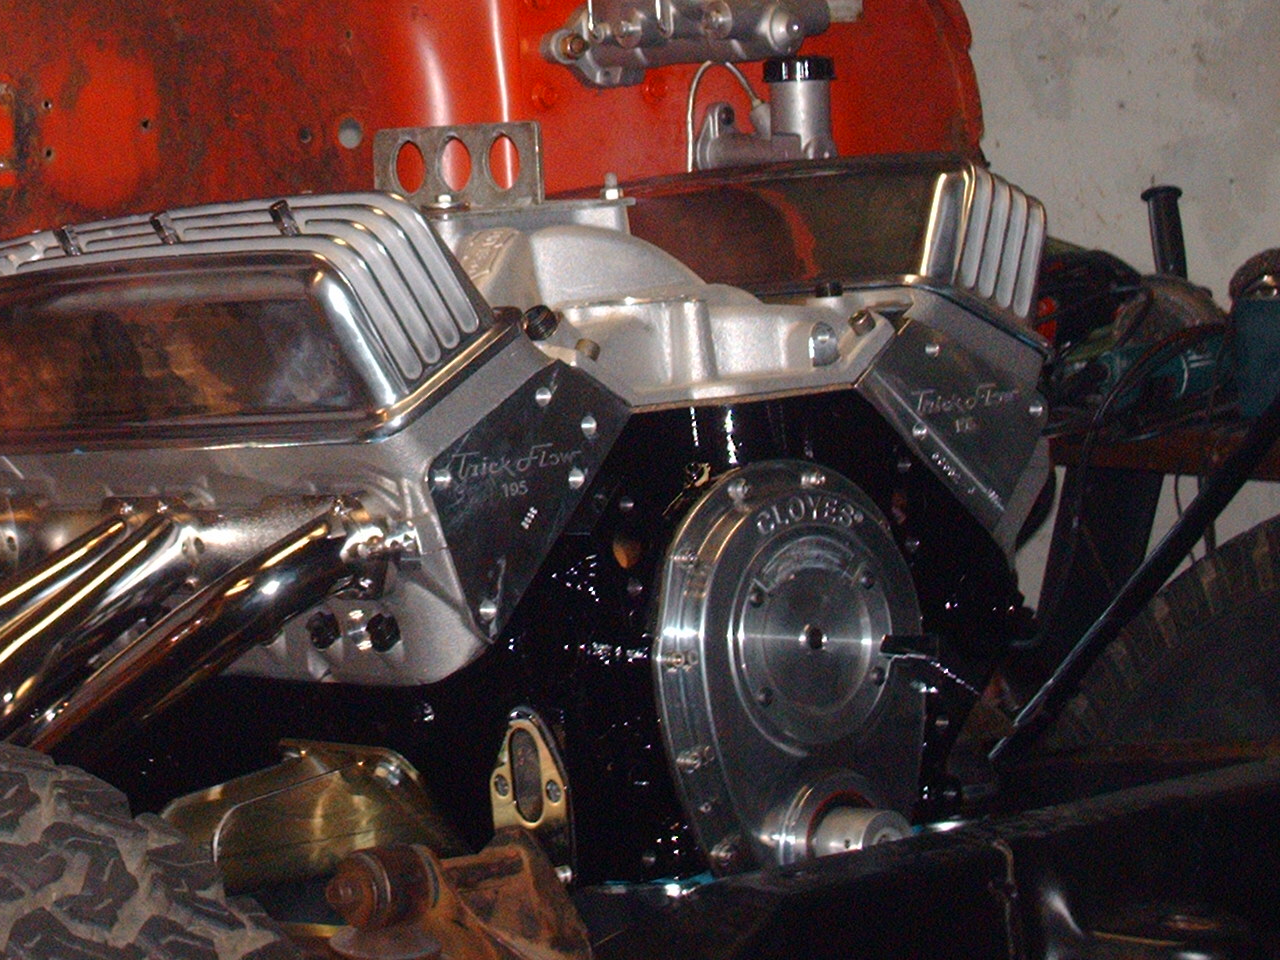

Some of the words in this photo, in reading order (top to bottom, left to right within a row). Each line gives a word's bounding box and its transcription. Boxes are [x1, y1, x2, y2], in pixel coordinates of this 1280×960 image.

[451, 450, 516, 480] Trick
[516, 442, 582, 472] Flow
[501, 479, 529, 498] 195
